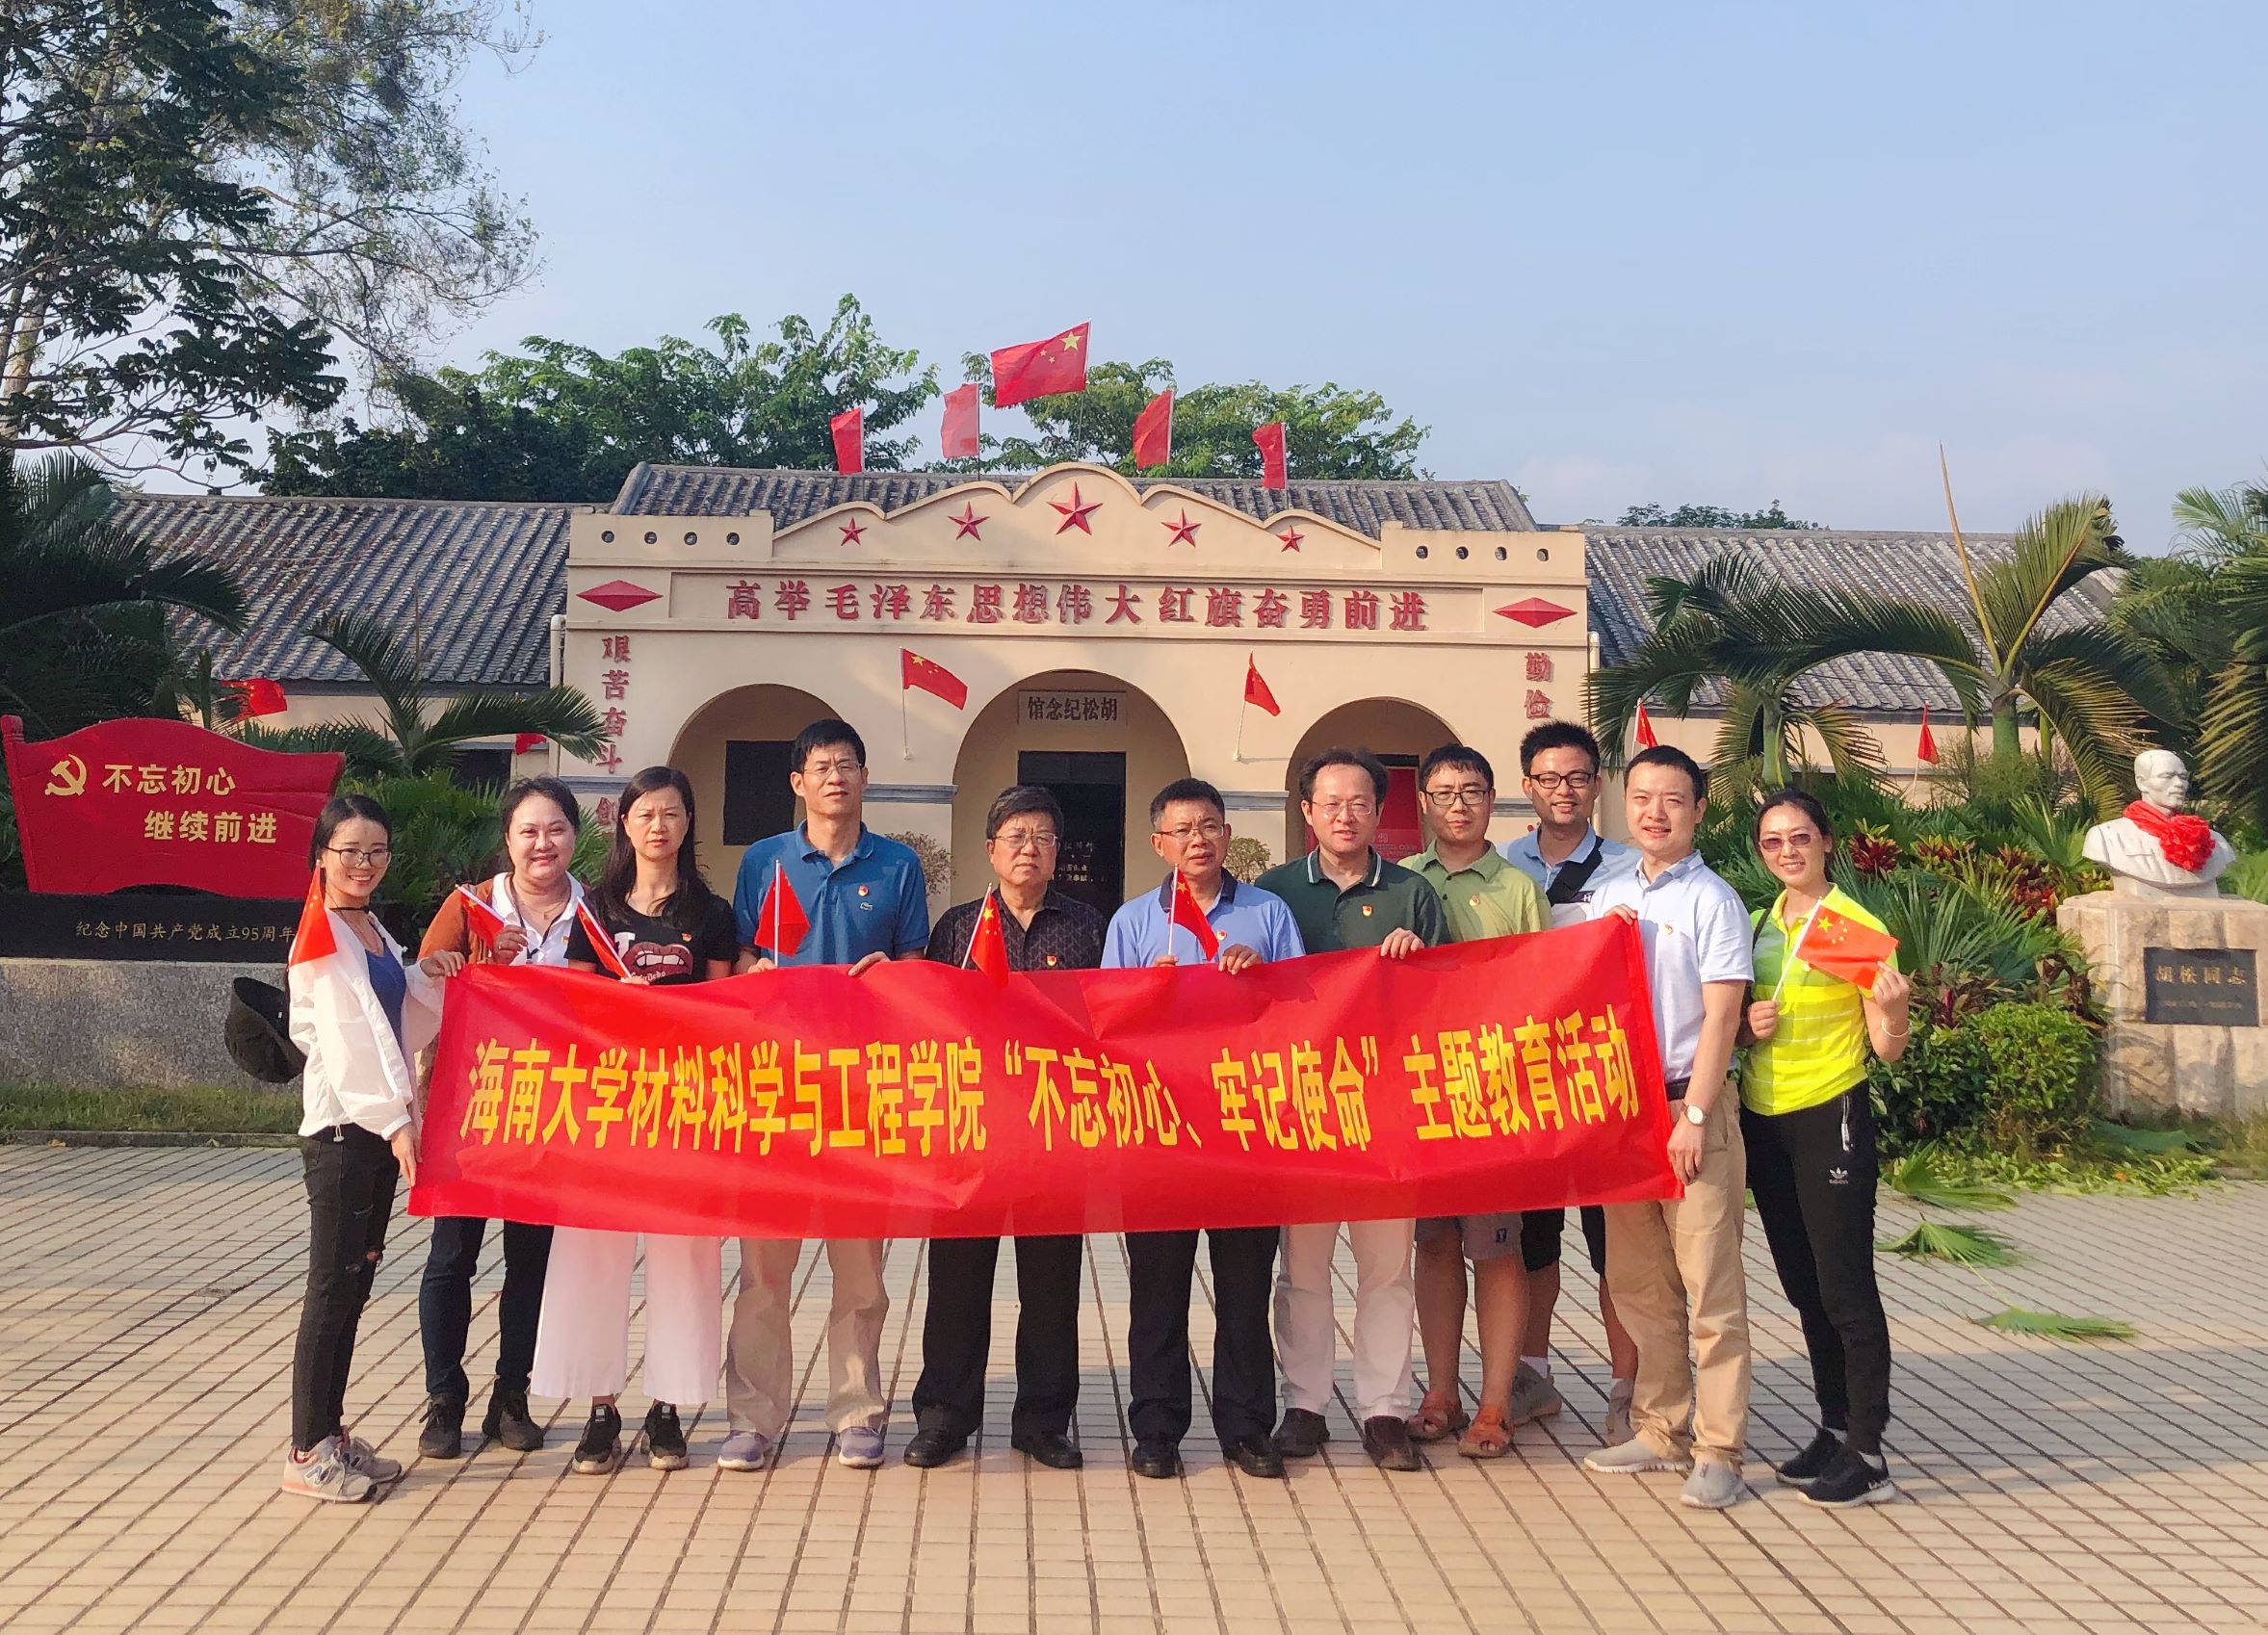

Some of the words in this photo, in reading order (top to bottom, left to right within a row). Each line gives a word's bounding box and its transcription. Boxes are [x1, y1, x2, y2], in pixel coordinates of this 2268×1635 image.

[726, 580, 1426, 631] 高举毛泽东思想伟大红旗奋勇前进
[102, 764, 236, 796] 不忘初心
[144, 810, 277, 843] 继续前进
[76, 921, 295, 943] 纪念中国共产党成立95周年
